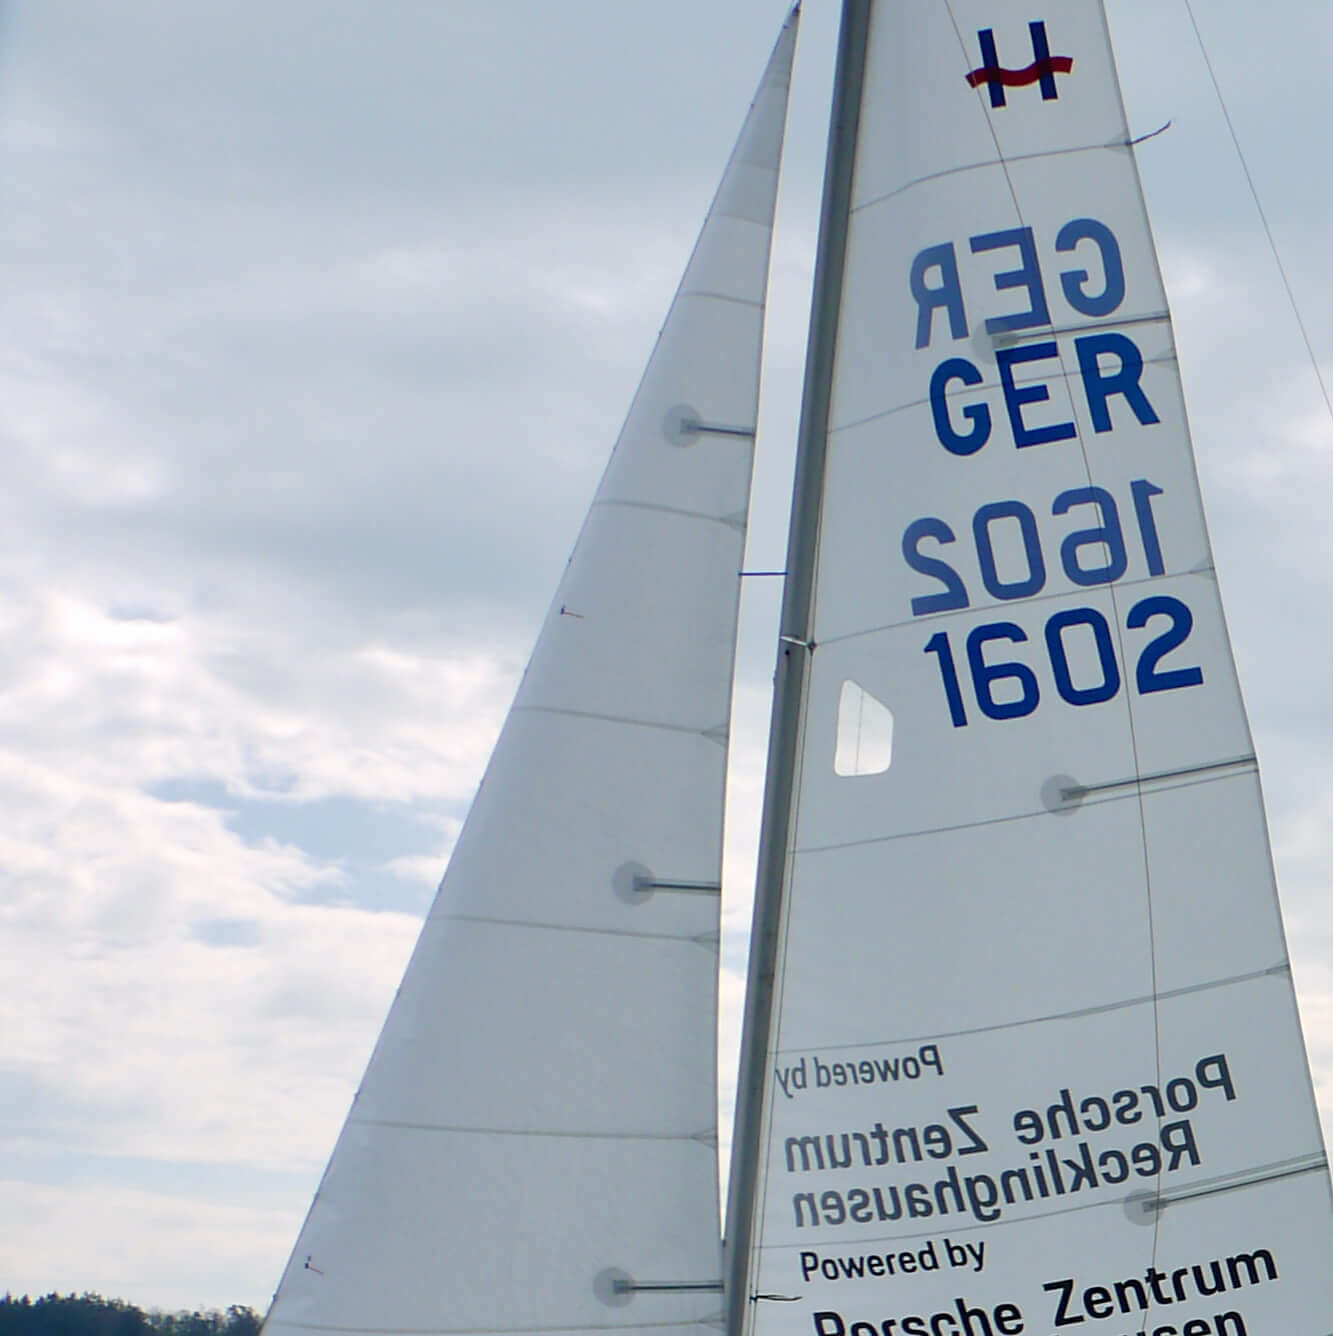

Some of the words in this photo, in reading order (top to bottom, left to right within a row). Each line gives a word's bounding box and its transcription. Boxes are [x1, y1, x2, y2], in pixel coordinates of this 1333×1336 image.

[929, 332, 1161, 456] GER
[923, 596, 1204, 728] 1602
[800, 1241, 939, 1282] Powered
[945, 1238, 985, 1271] by
[1043, 1248, 1277, 1328] Zentrum
